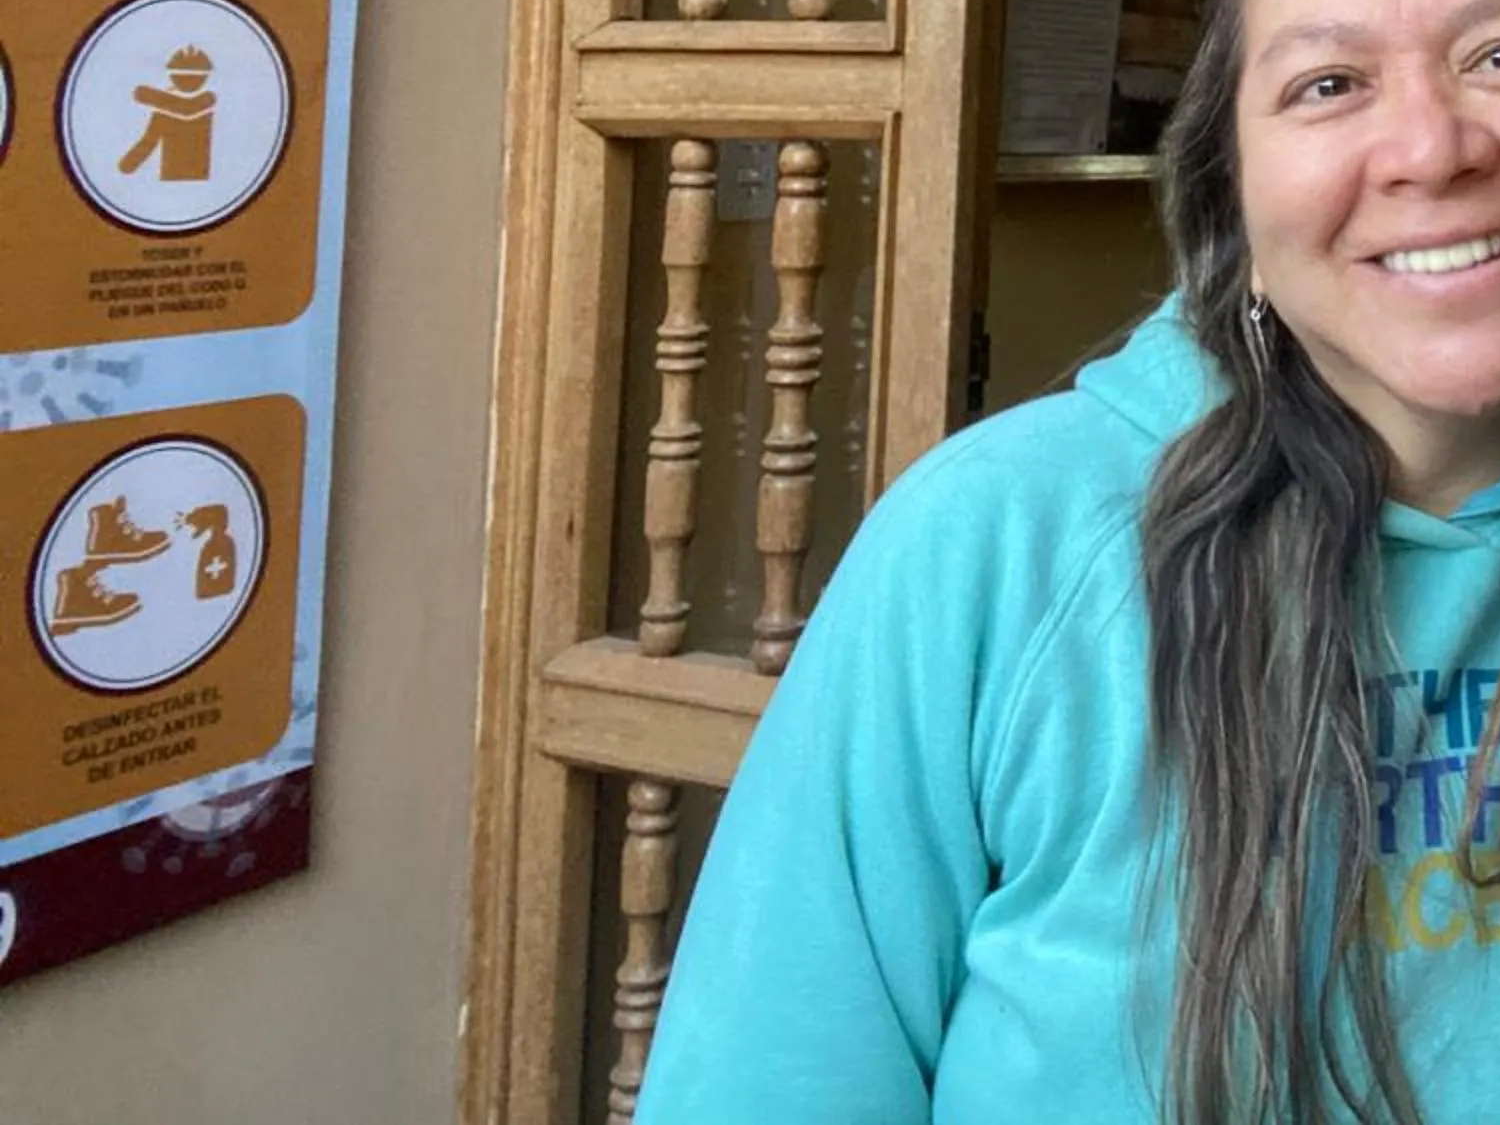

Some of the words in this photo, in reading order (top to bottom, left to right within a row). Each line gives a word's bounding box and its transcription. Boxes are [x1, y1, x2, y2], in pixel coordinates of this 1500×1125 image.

[62, 691, 196, 743] DESINFECTAR
[200, 686, 222, 704] EL
[62, 727, 158, 766] CALZADO
[161, 707, 222, 737] ANTES
[87, 761, 115, 784] DE
[119, 735, 198, 774] ENTRAR
